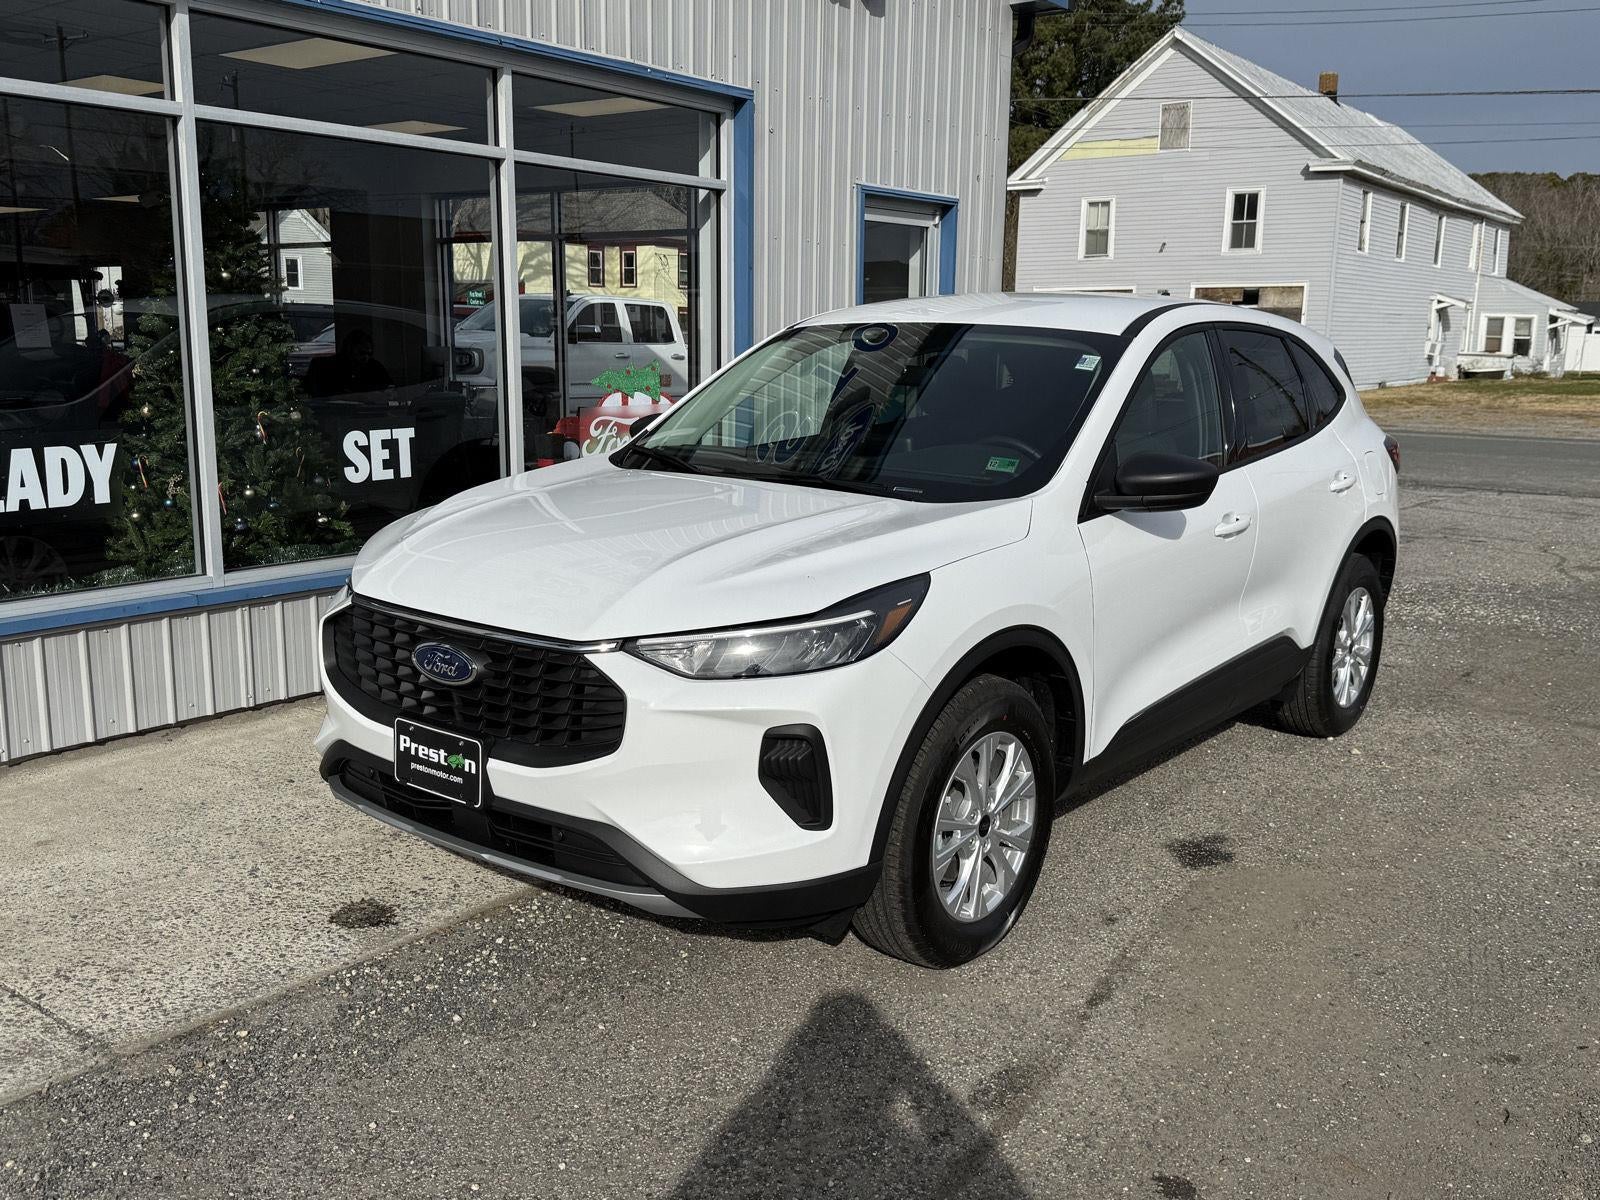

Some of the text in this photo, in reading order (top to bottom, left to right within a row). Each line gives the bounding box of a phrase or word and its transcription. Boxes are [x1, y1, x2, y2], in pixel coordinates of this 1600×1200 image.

[342, 427, 416, 484] SET
[0, 442, 118, 513] ADY
[424, 650, 459, 677] Ford
[410, 762, 463, 784] prestonmotor.com
